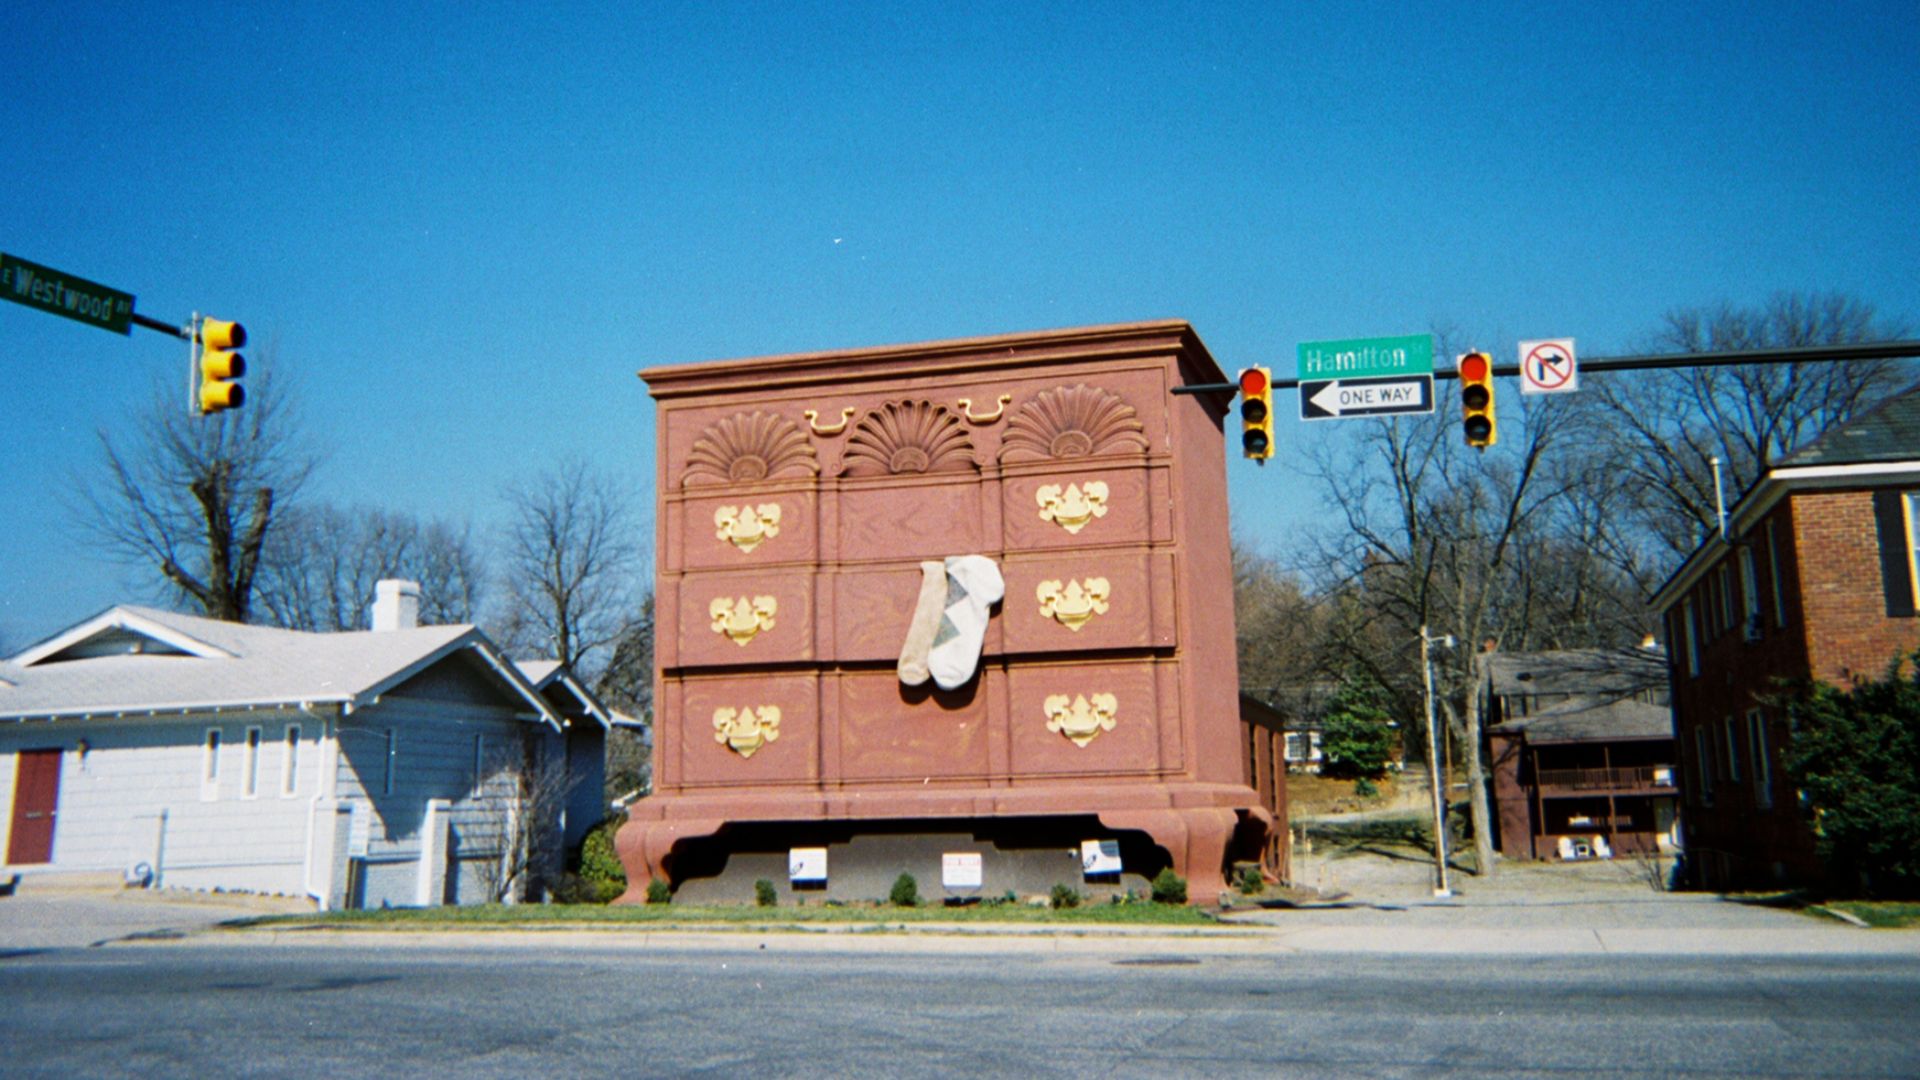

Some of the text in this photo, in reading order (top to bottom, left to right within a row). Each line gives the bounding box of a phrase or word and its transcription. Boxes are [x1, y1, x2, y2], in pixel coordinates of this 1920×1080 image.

[2, 268, 11, 284] E
[15, 266, 113, 321] Westwood
[1306, 347, 1405, 372] Hamilton
[1340, 387, 1412, 405] ONE WAY
